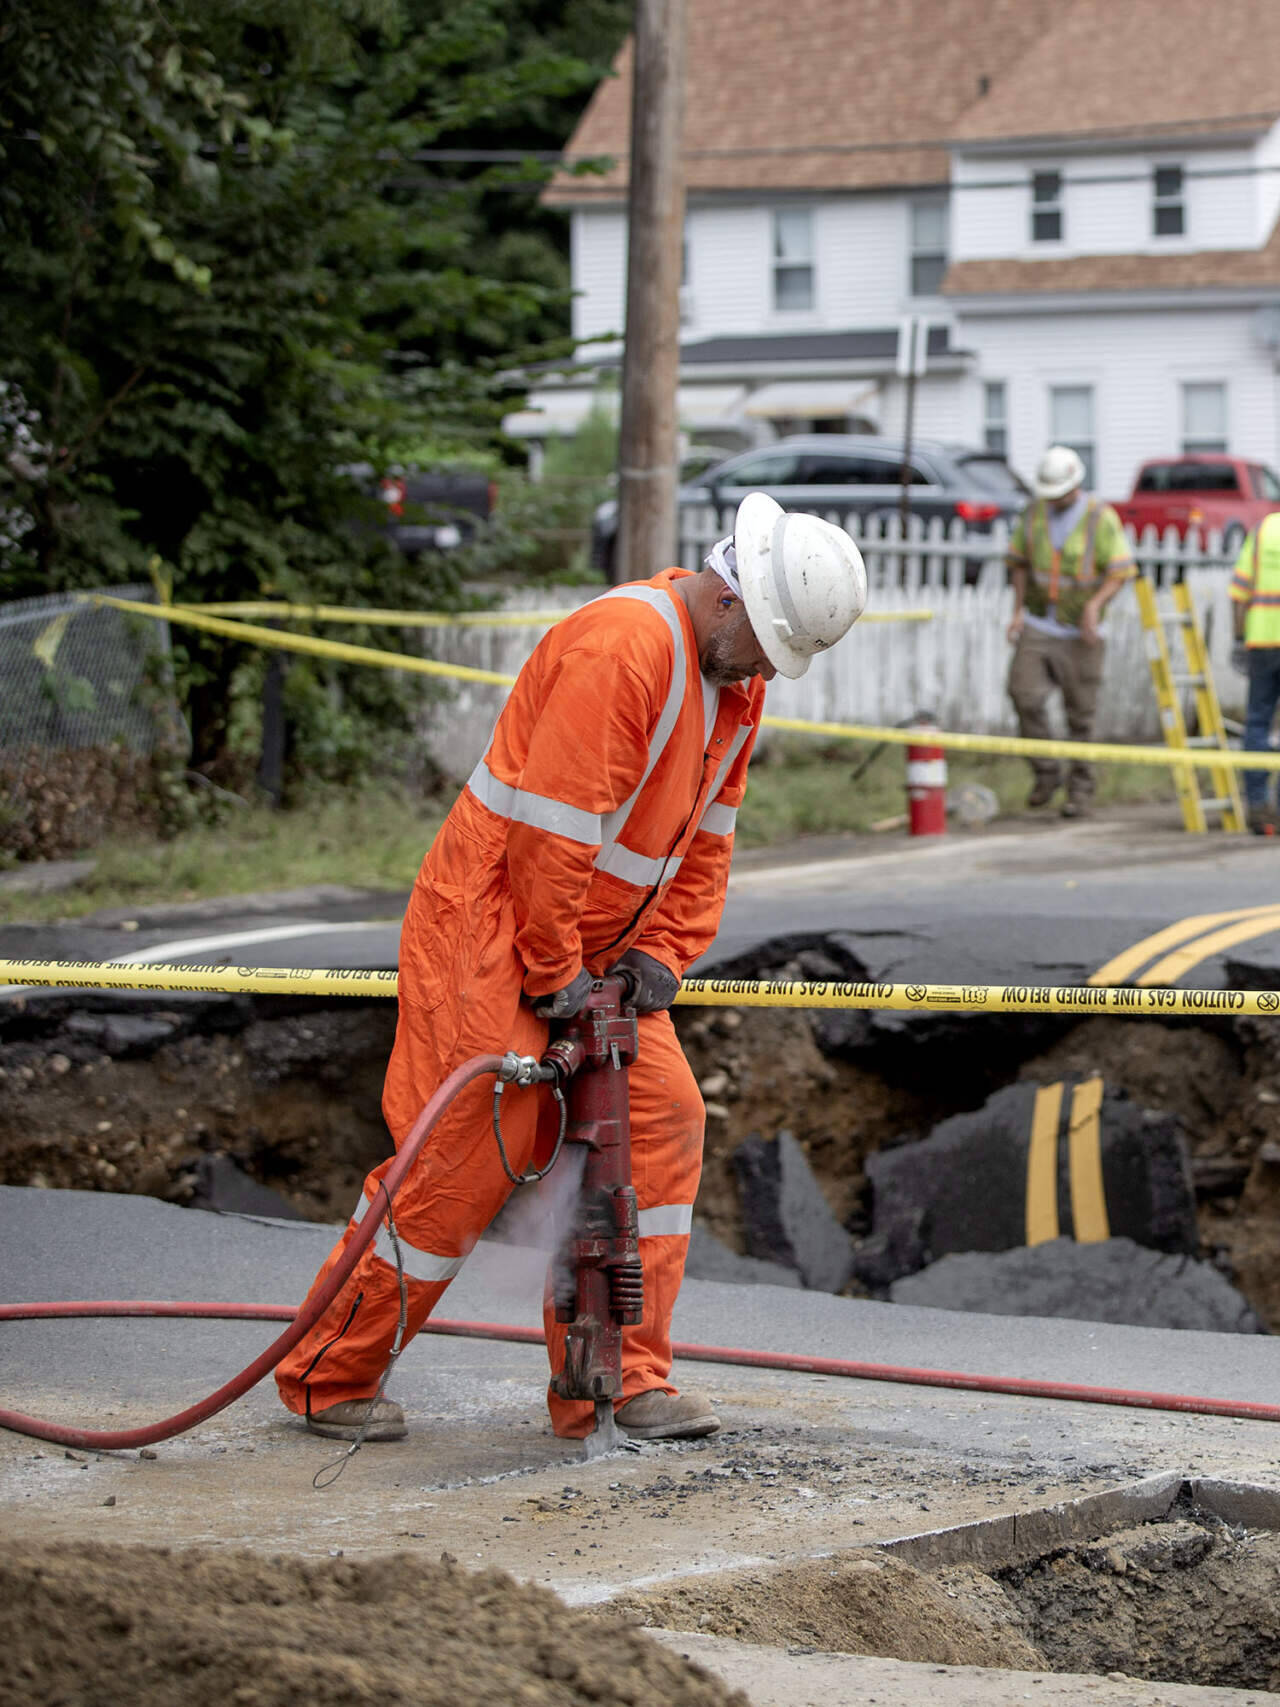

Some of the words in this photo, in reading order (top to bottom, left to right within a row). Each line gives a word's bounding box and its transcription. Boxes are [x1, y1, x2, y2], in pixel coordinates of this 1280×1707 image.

[711, 979, 759, 994] BURIED
[765, 981, 795, 995] LINE
[800, 982, 827, 997] GAS
[833, 982, 894, 998] CAUTION
[1001, 986, 1050, 1003] BELOW
[962, 988, 988, 1004] 811
[1056, 987, 1107, 1005] BURIED
[1113, 989, 1142, 1006] LINE
[1148, 990, 1177, 1007] GAS
[1182, 991, 1245, 1008] CAUTION
